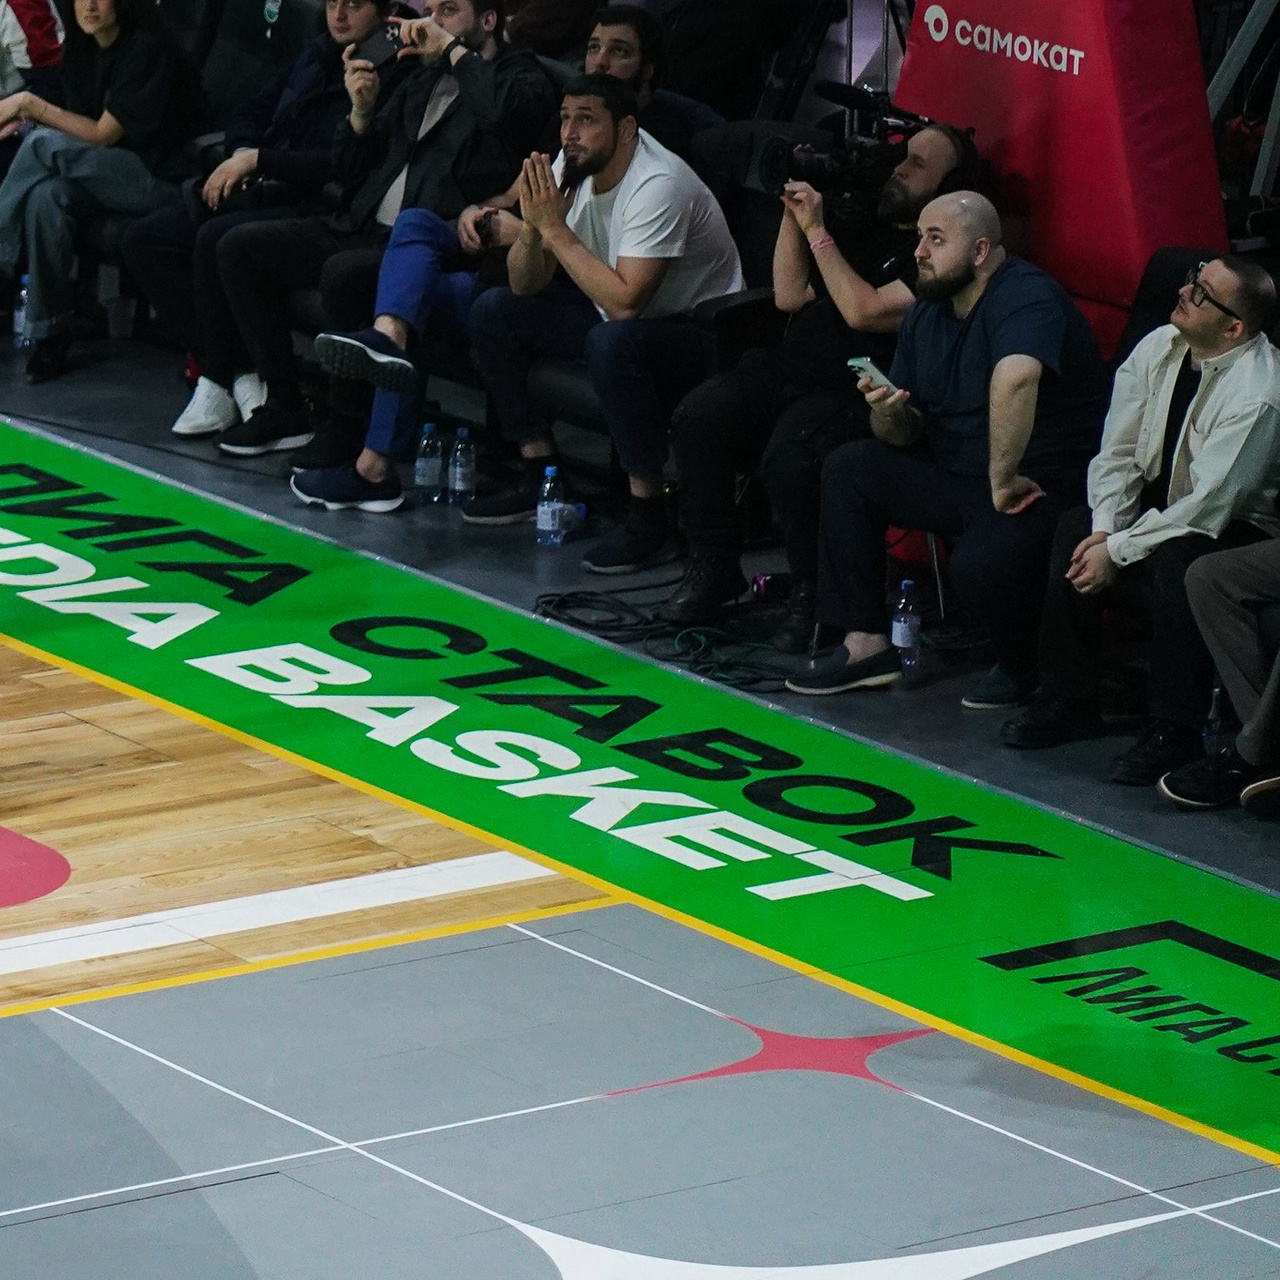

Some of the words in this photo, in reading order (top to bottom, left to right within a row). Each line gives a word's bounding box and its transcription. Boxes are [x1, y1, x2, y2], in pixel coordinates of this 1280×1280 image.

[955, 19, 1085, 76] самокат
[184, 642, 936, 902] BASKET
[328, 615, 1064, 881] СТАВОК
[1028, 966, 1252, 1044] ЛИГА
